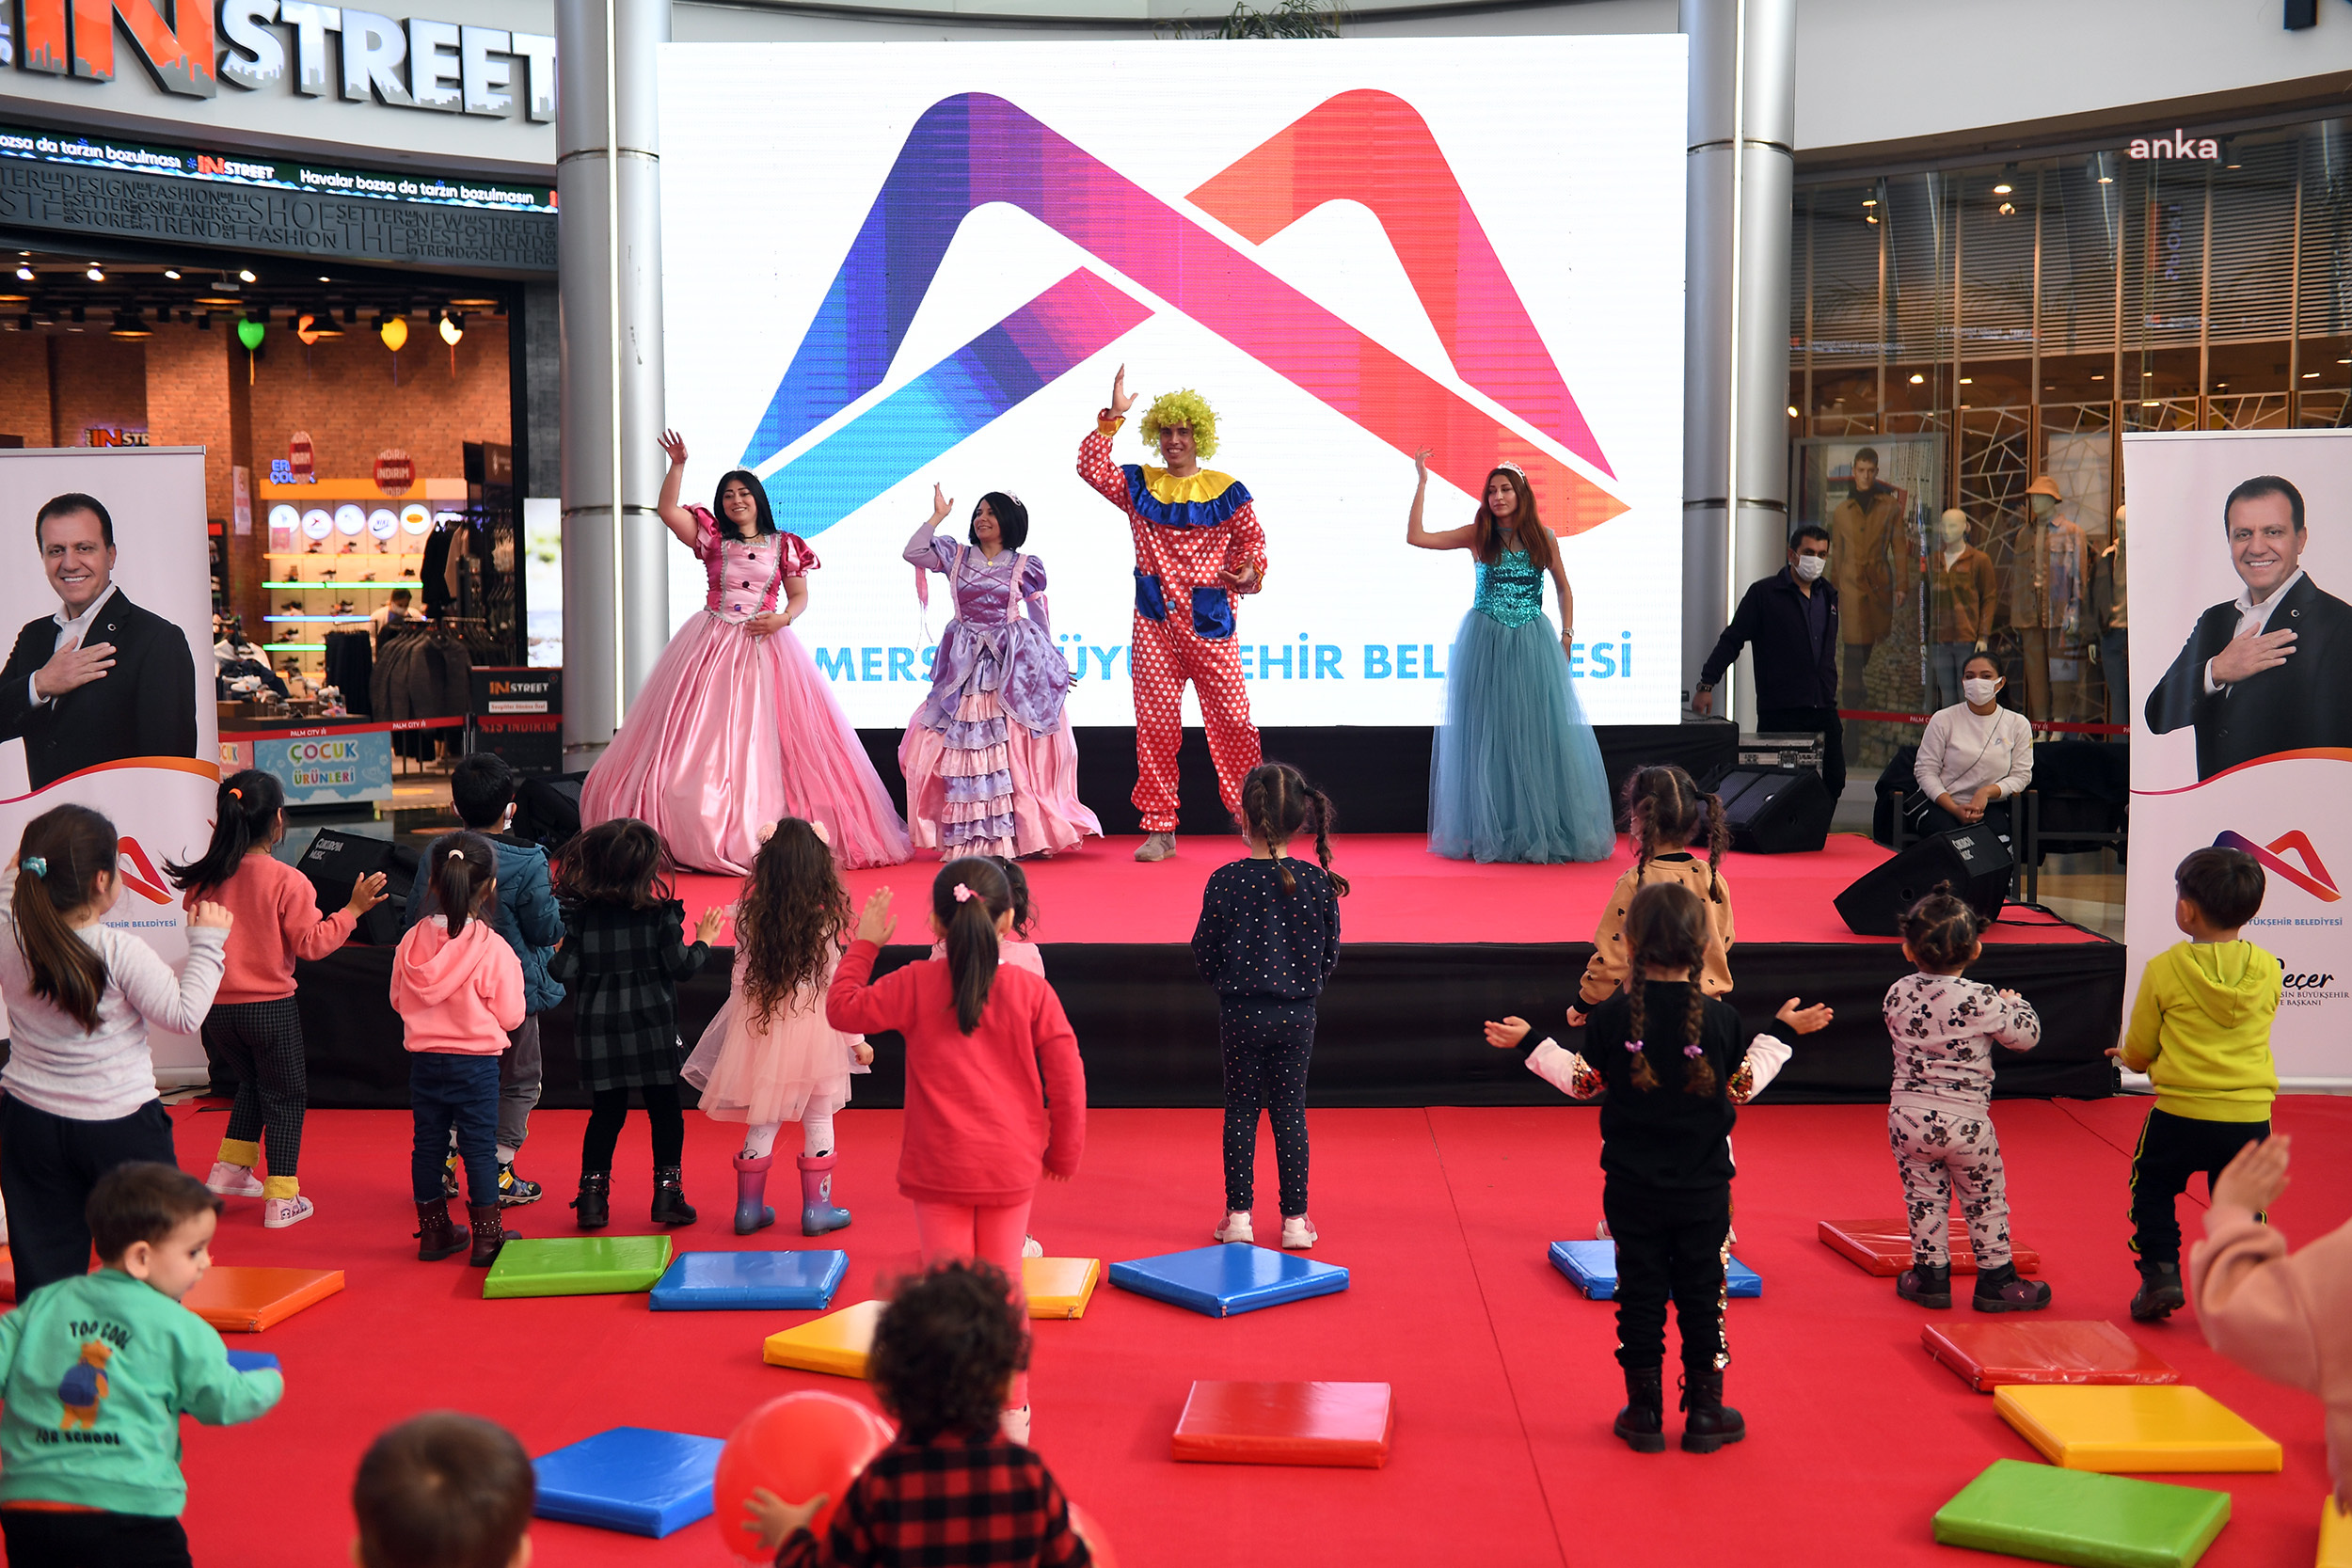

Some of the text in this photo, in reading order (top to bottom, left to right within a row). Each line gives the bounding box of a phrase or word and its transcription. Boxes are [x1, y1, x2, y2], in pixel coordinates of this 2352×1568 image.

[36, 136, 58, 153] da
[61, 173, 136, 199] DESIGN
[149, 182, 220, 205] FASHION
[299, 168, 355, 188] Havalar
[356, 175, 396, 193] bozsa
[398, 180, 418, 195] da
[460, 185, 534, 204] bozulmasın
[150, 199, 221, 221] SNEAKER
[247, 194, 337, 232] SHOE
[336, 203, 405, 225] SETTER
[151, 214, 221, 237] TREND
[416, 210, 463, 230] NEW
[478, 216, 542, 235] STREET
[248, 225, 337, 249] FASHION
[336, 219, 406, 255] THE
[416, 228, 463, 246] BEST
[478, 247, 547, 265] SETTER
[290, 729, 306, 737] PALM
[407, 721, 420, 729] CITY
[289, 742, 358, 763] ÇOCUK
[294, 768, 355, 784] ÜRÜNLERİ
[132, 918, 177, 928] BELEDİYESİ
[2295, 917, 2343, 927] BELEDİYESİ
[2297, 990, 2349, 999] BÜYÜKŞEHİR
[70, 1321, 99, 1338] TOO
